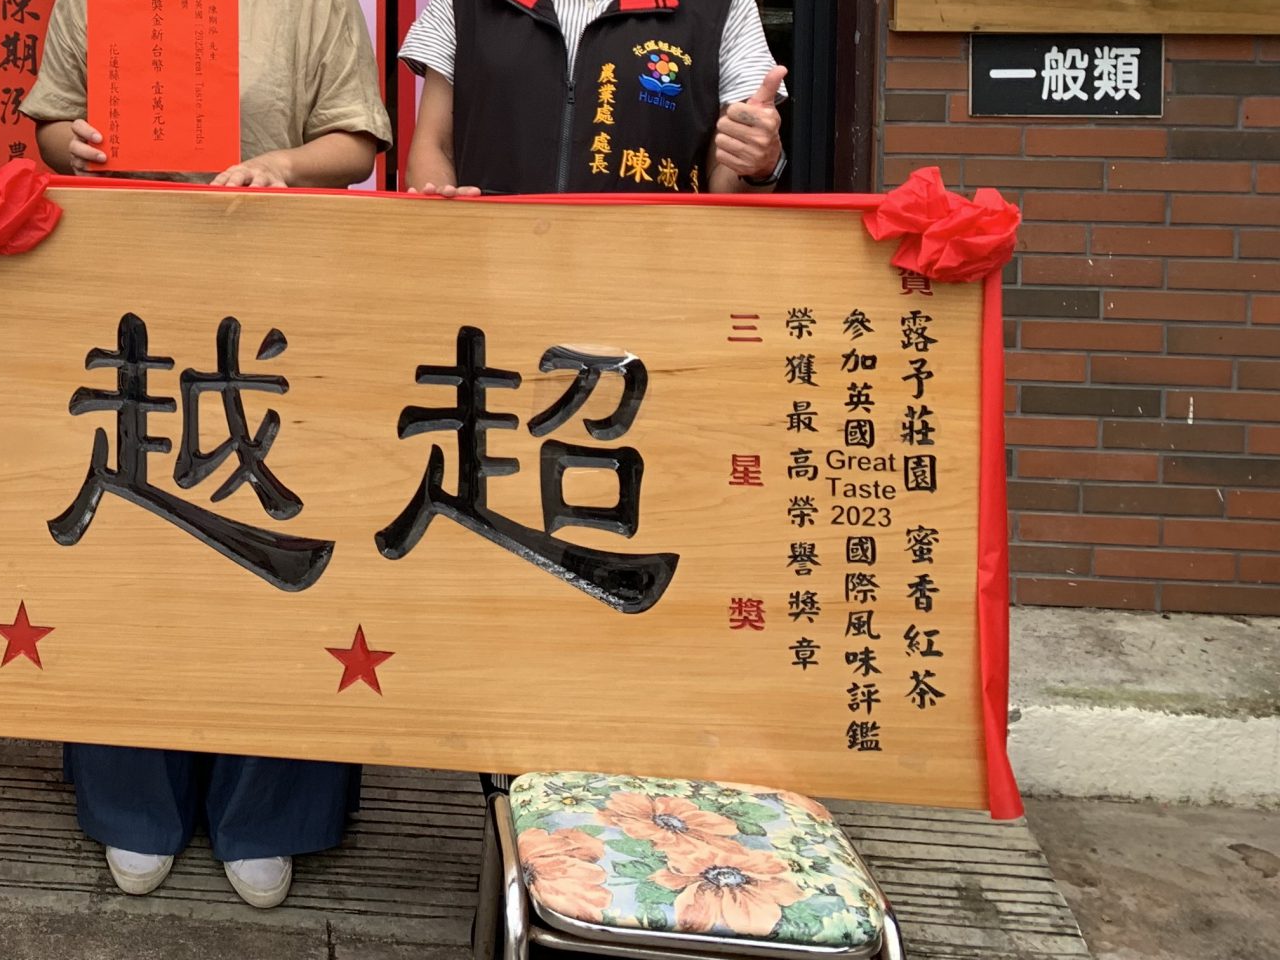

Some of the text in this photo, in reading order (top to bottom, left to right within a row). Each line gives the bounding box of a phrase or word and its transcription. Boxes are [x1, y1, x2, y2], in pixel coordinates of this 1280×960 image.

[639, 90, 677, 112] Hualien
[989, 45, 1142, 101] 一般類
[726, 313, 767, 632] 三星獎
[784, 306, 822, 672] 榮獲最高榮譽獎章
[825, 449, 897, 473] Great
[825, 477, 897, 500] Taste
[830, 505, 892, 528] 2023
[844, 535, 883, 753] 國際風味評鑑
[902, 524, 947, 710] 蜜香紅茶
